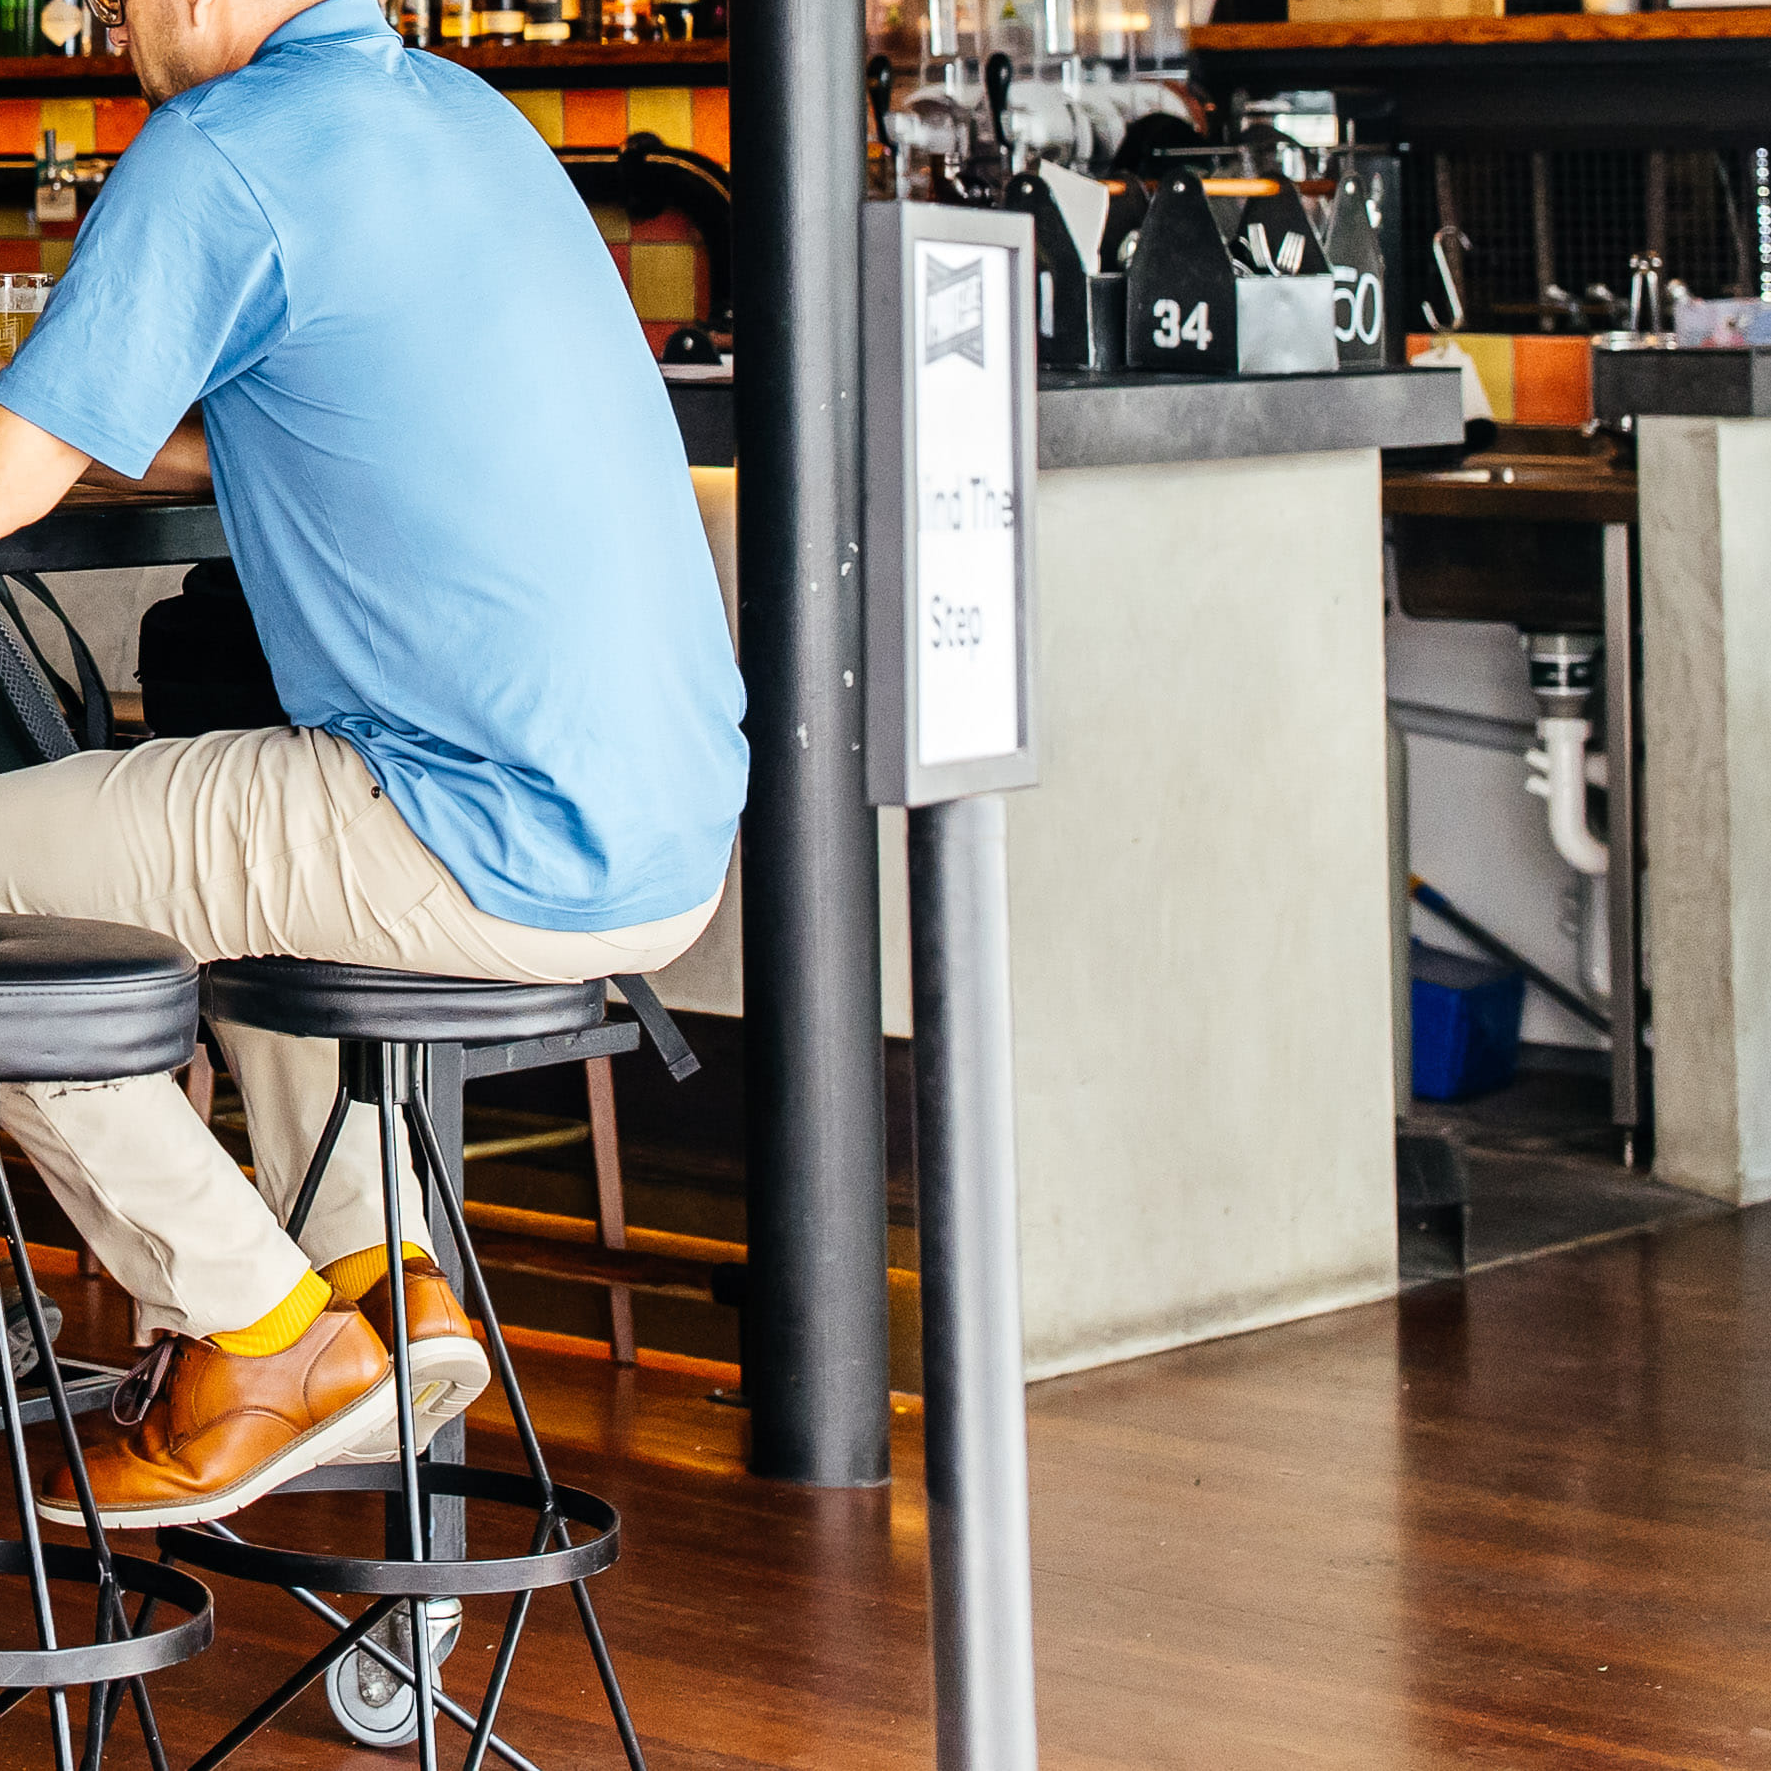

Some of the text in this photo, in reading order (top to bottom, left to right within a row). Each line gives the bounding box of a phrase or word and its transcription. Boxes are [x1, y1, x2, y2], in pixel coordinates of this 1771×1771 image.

[1153, 299, 1212, 351] 34
[1331, 265, 1382, 345] 50
[921, 475, 962, 531] ind
[930, 593, 983, 661] Step
